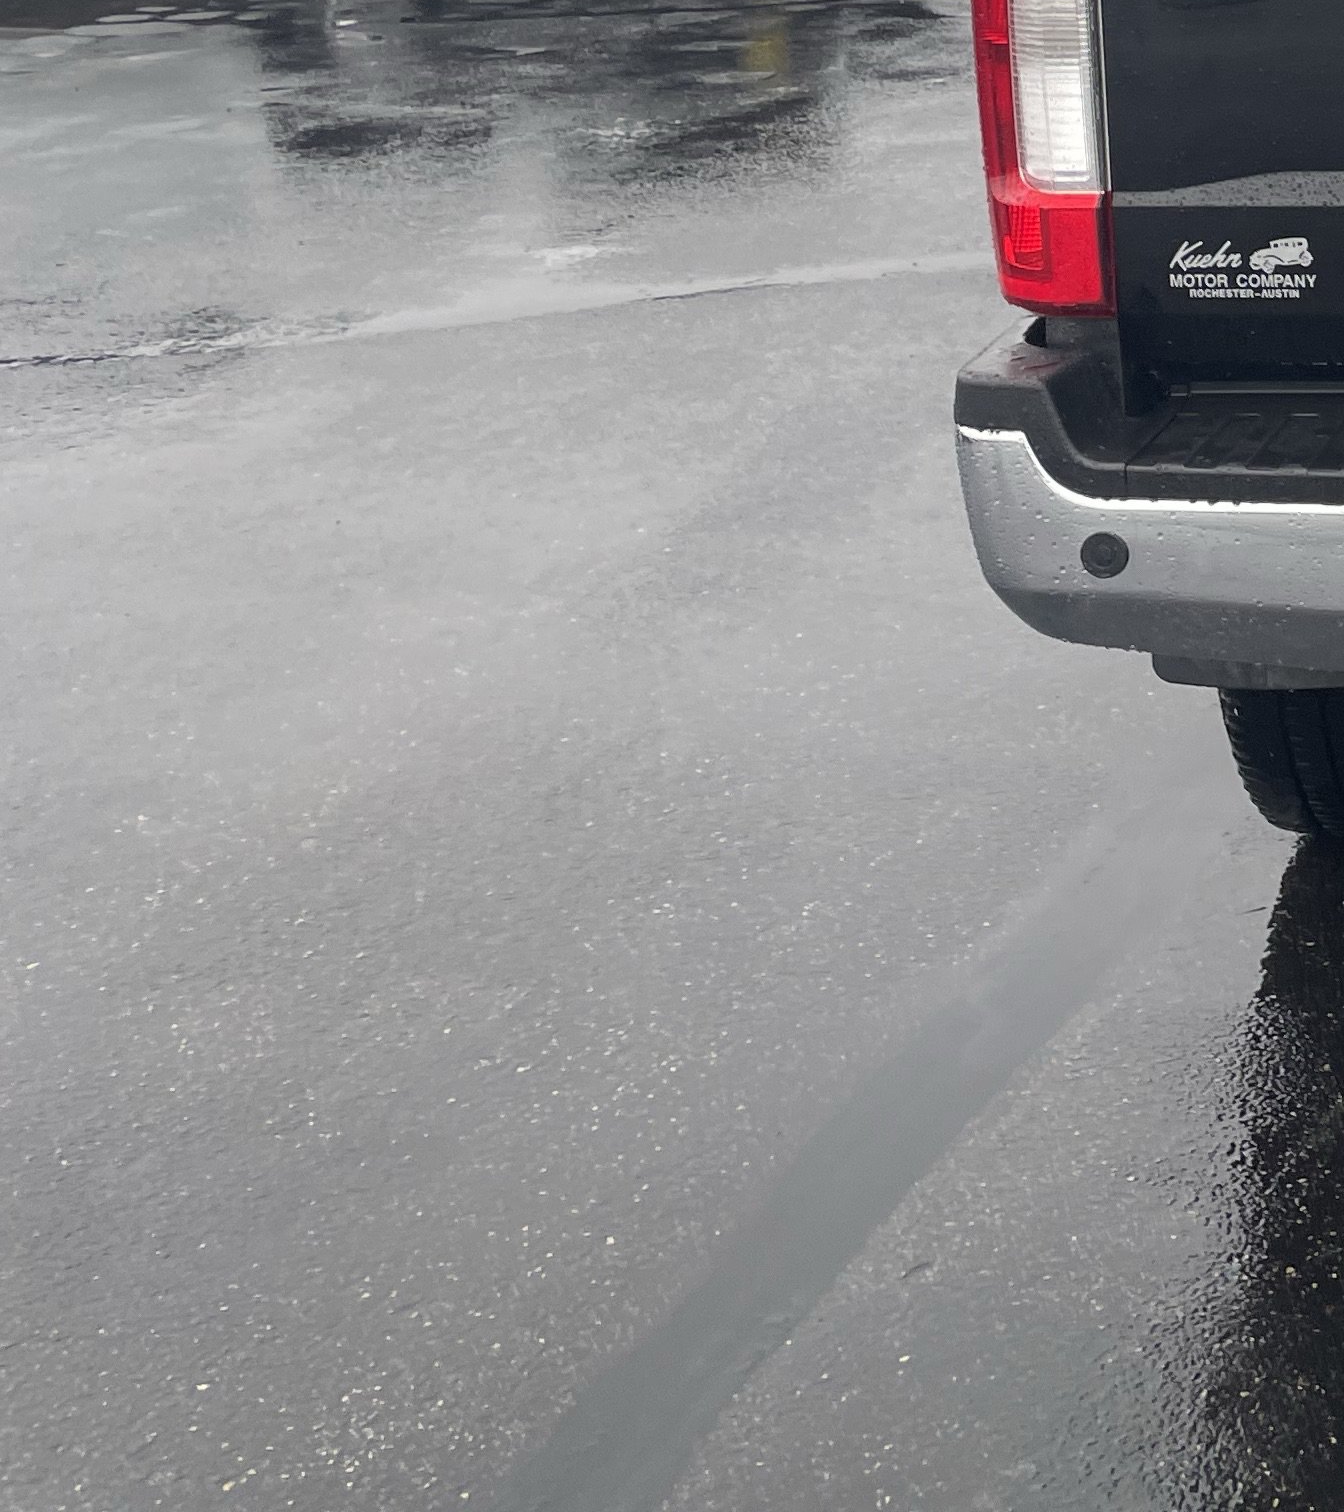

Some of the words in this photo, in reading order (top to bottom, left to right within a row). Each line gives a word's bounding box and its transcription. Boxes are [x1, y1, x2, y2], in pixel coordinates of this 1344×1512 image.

[1169, 240, 1243, 272] Kuehn
[1169, 273, 1229, 288] MOTOR
[1235, 273, 1317, 288] COMPANY
[1189, 288, 1300, 299] ROCHESTER-AUSTIN
